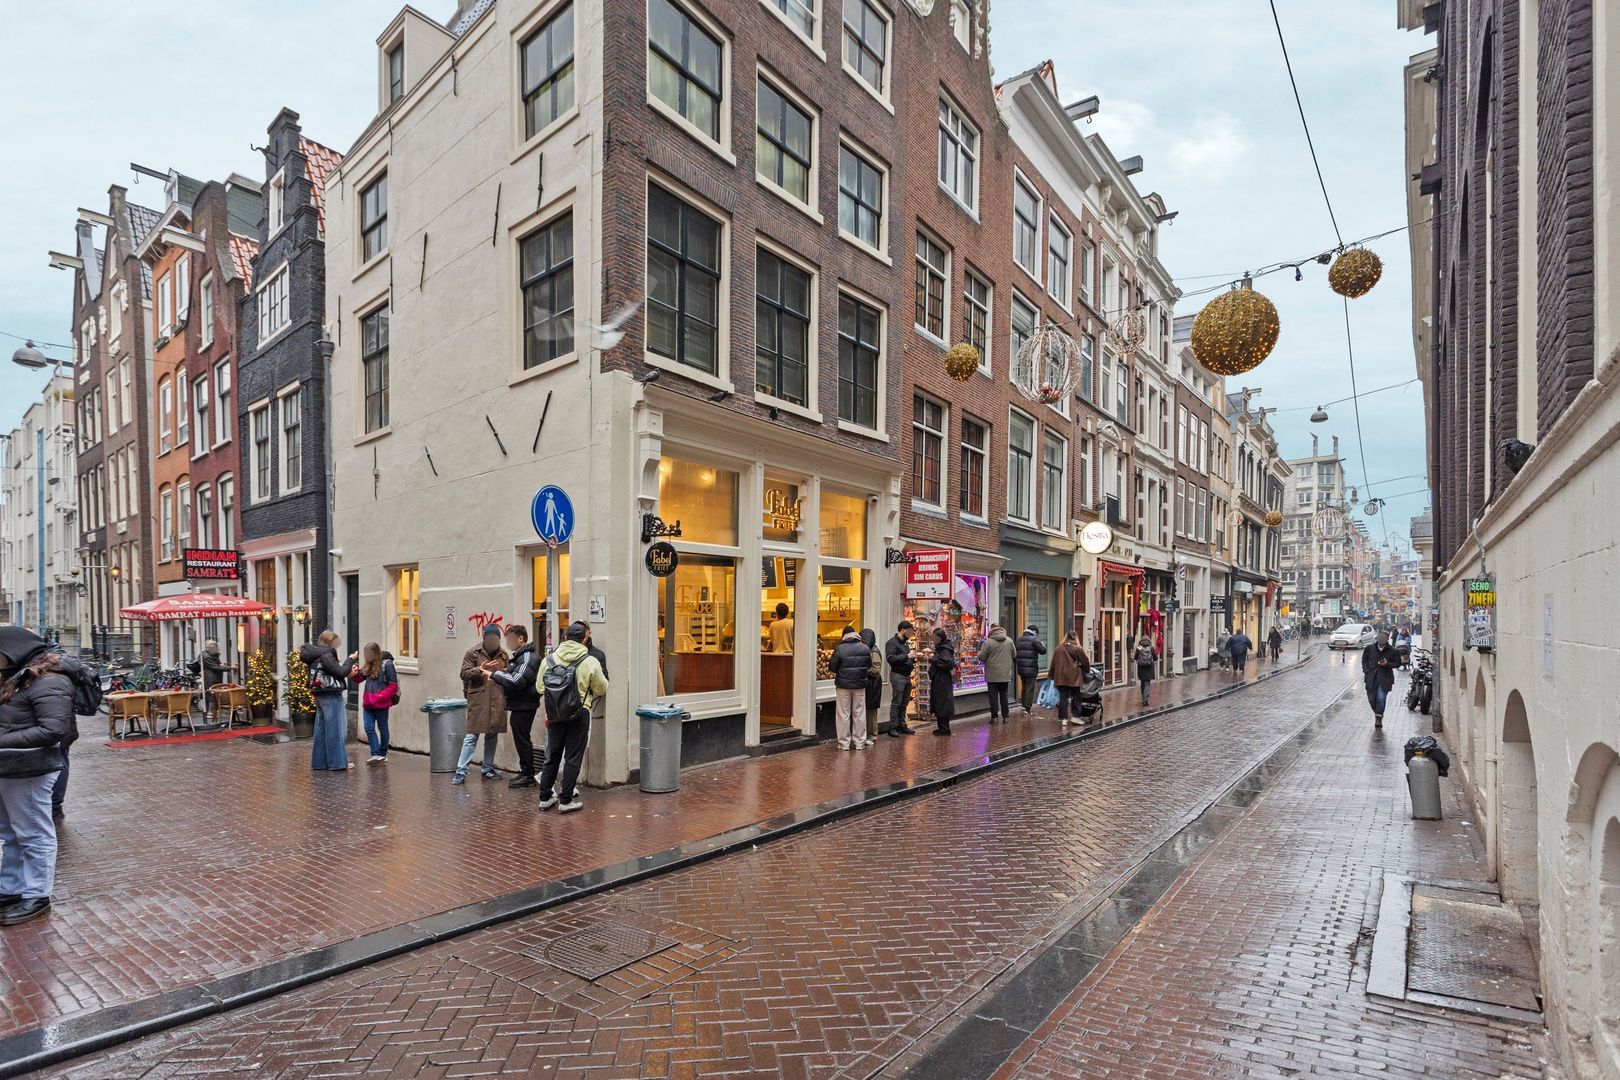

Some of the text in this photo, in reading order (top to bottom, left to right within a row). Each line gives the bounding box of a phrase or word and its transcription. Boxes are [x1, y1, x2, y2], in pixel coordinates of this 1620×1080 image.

[186, 550, 237, 561] INDIAN
[650, 549, 672, 566] Fabel
[187, 568, 231, 578] SAMRAT
[914, 573, 924, 581] SIM
[157, 611, 200, 619] SAMRAT
